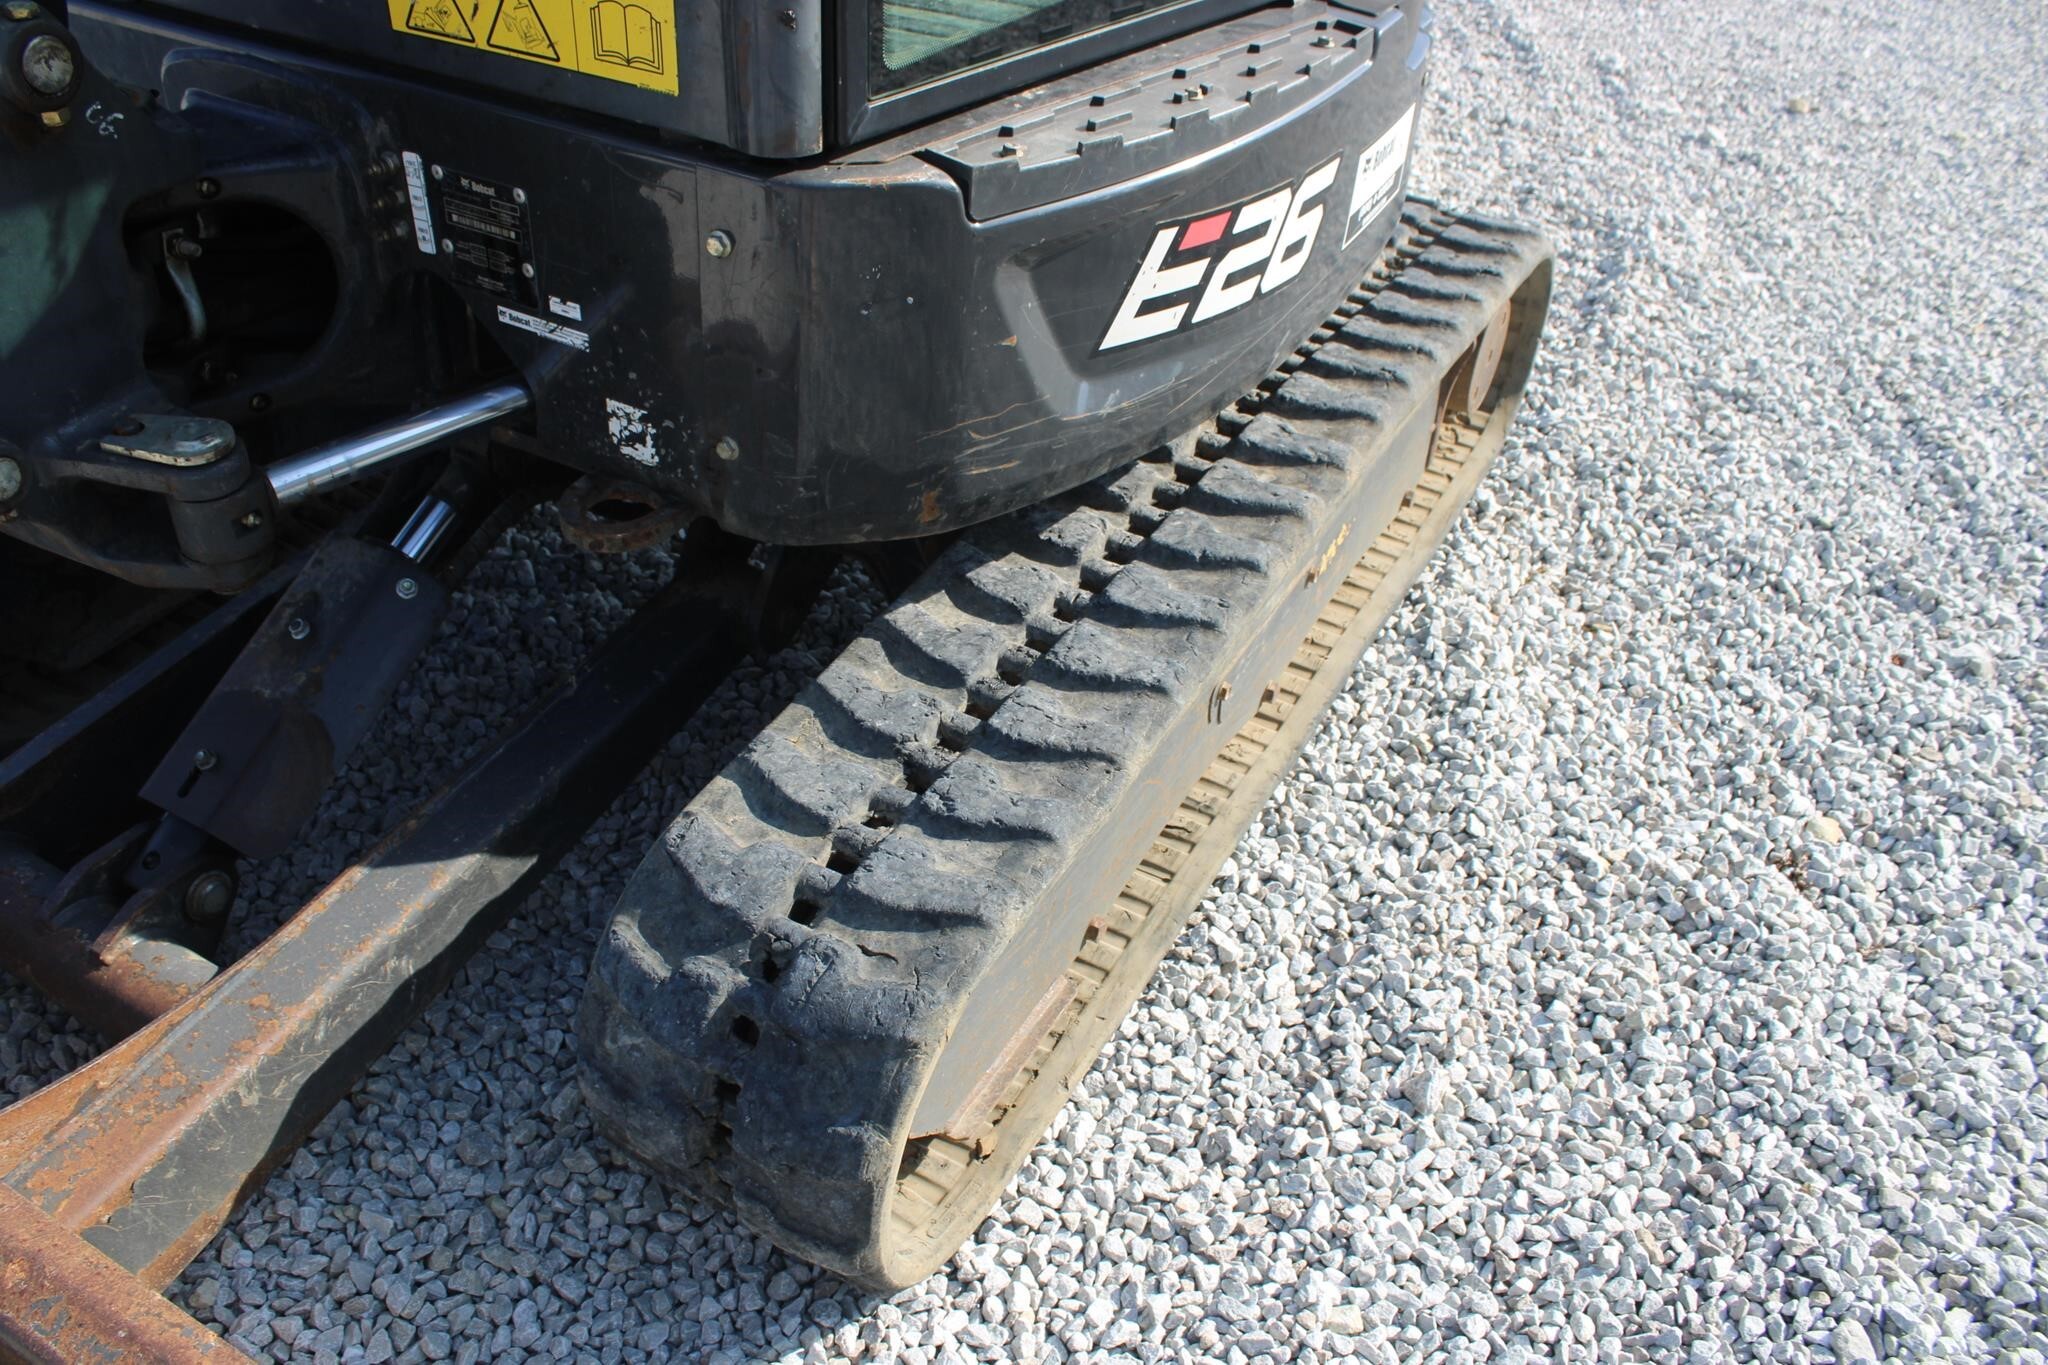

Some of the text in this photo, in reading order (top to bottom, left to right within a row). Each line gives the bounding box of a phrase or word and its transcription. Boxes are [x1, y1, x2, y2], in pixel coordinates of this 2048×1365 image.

[471, 180, 496, 197] Bobcat
[1098, 157, 1341, 351] E26
[508, 312, 531, 328] Bobcat
